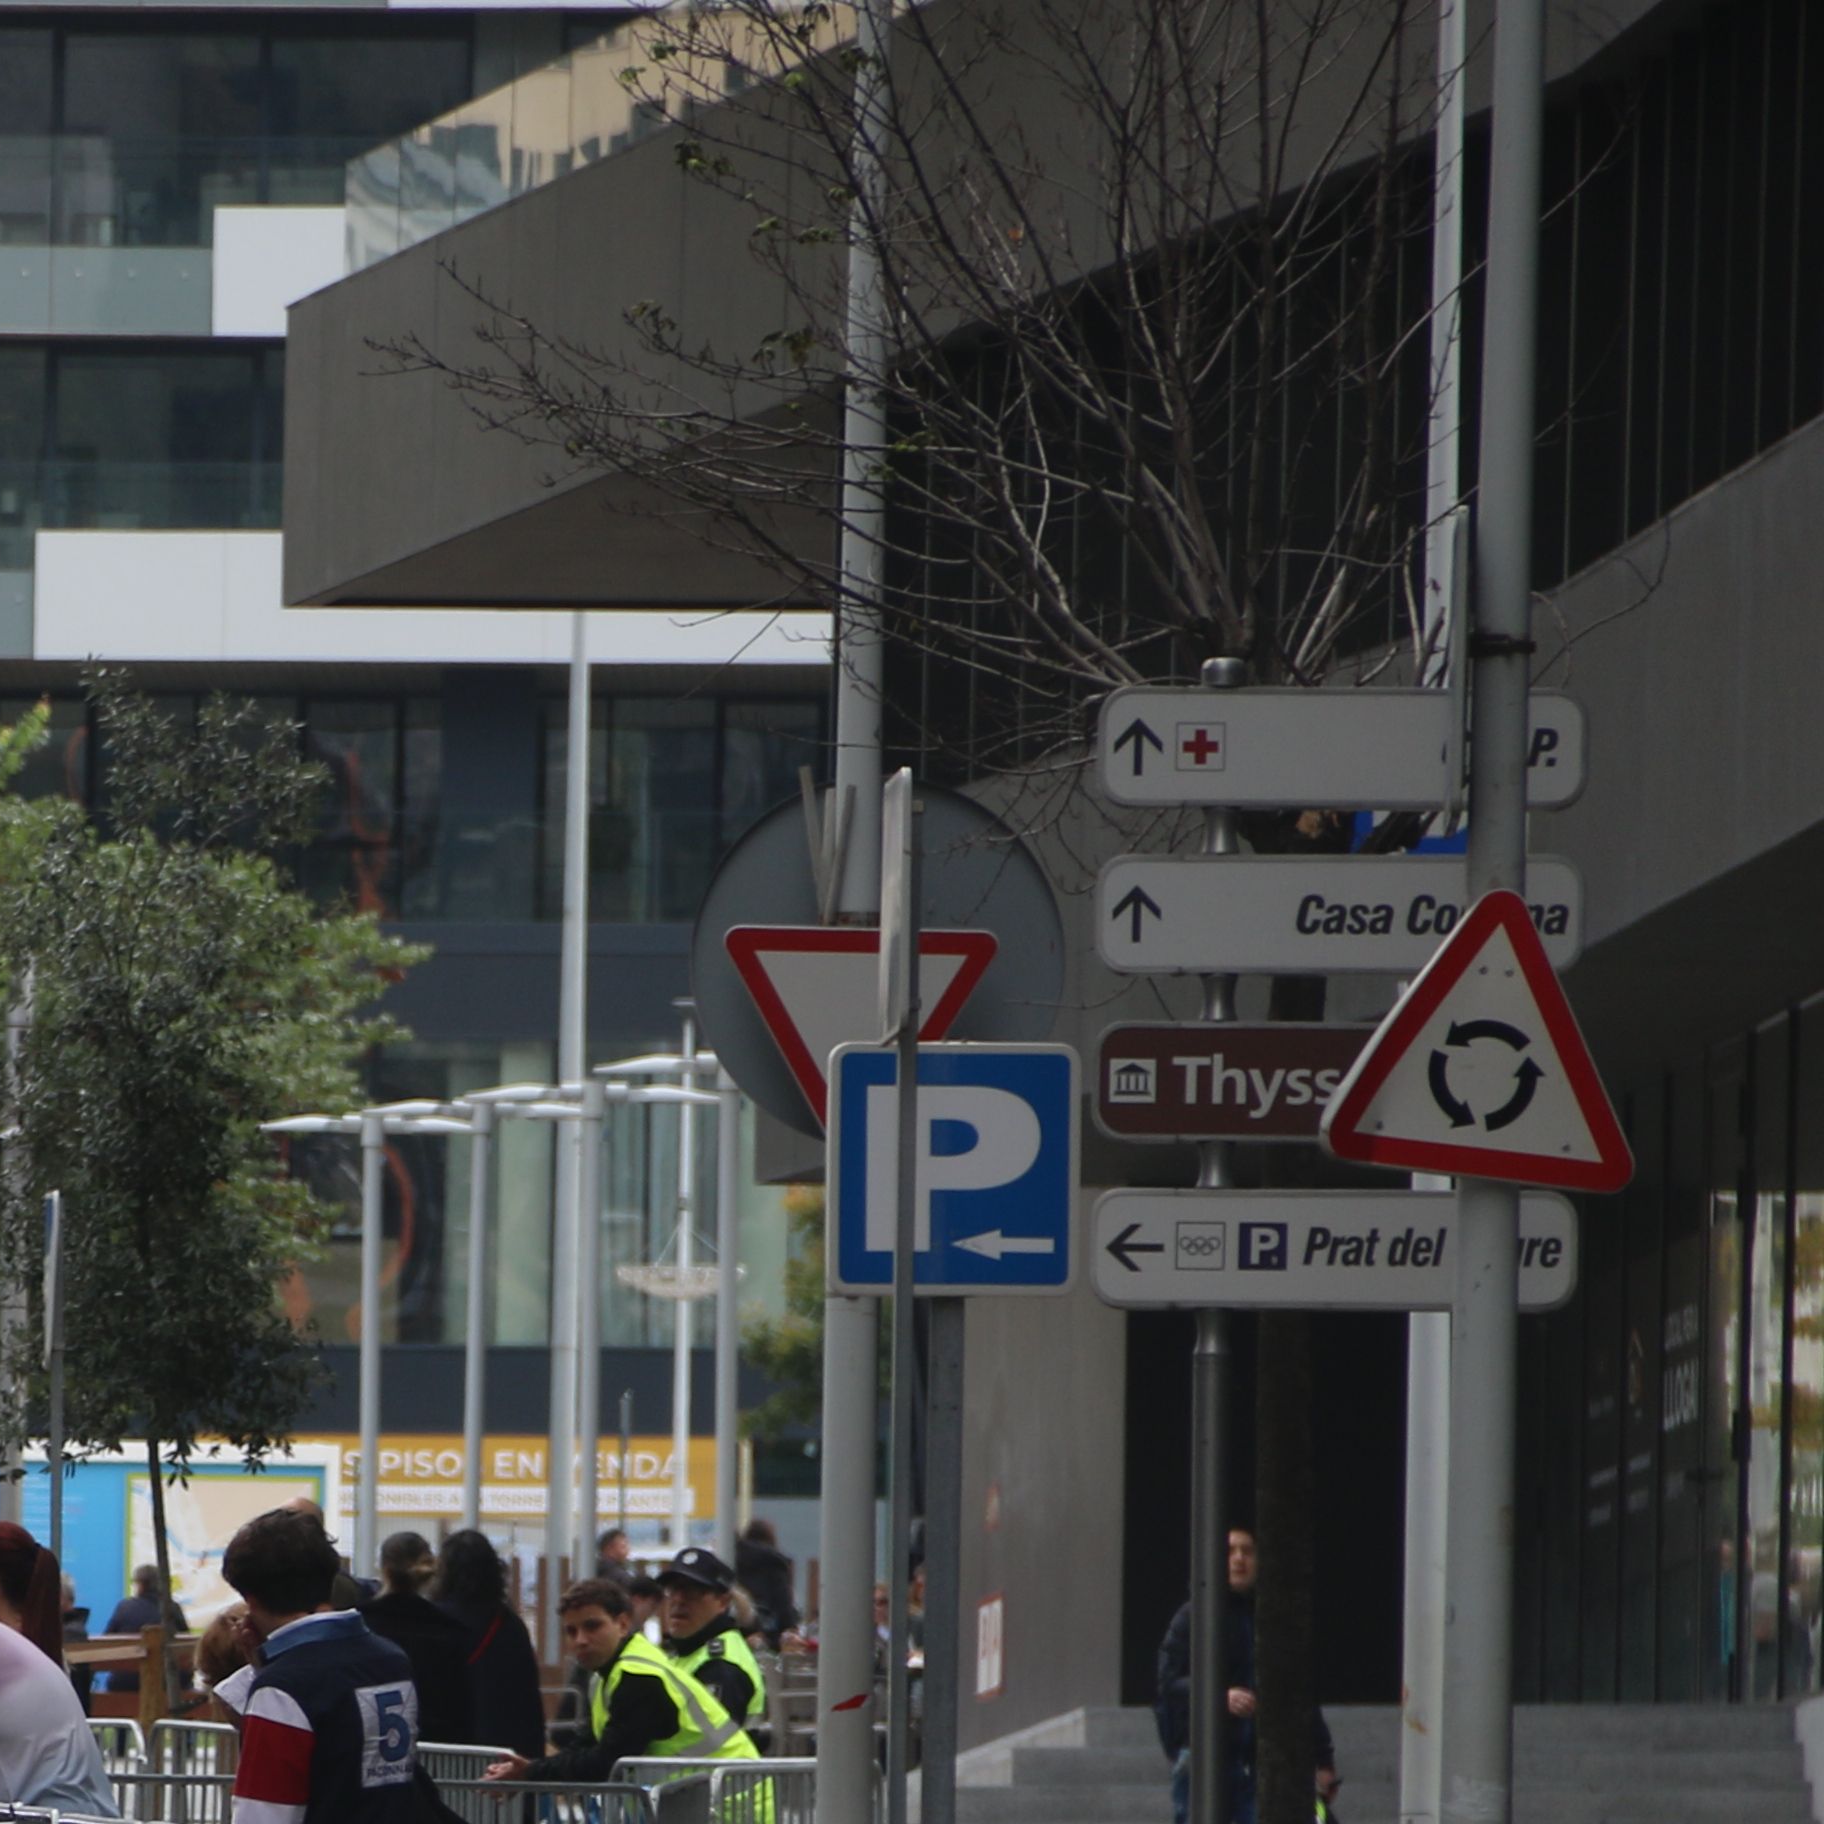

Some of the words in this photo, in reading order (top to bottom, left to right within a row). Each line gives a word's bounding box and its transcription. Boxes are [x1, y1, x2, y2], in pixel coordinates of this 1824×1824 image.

[1296, 894, 1394, 936] Casa
[1172, 1053, 1342, 1118] Thyss
[865, 1085, 1041, 1252] P
[1303, 1226, 1378, 1267] Prat
[1388, 1226, 1447, 1268] del
[379, 1451, 484, 1479] PISO
[494, 1452, 544, 1479] EN
[375, 1690, 411, 1763] 5
